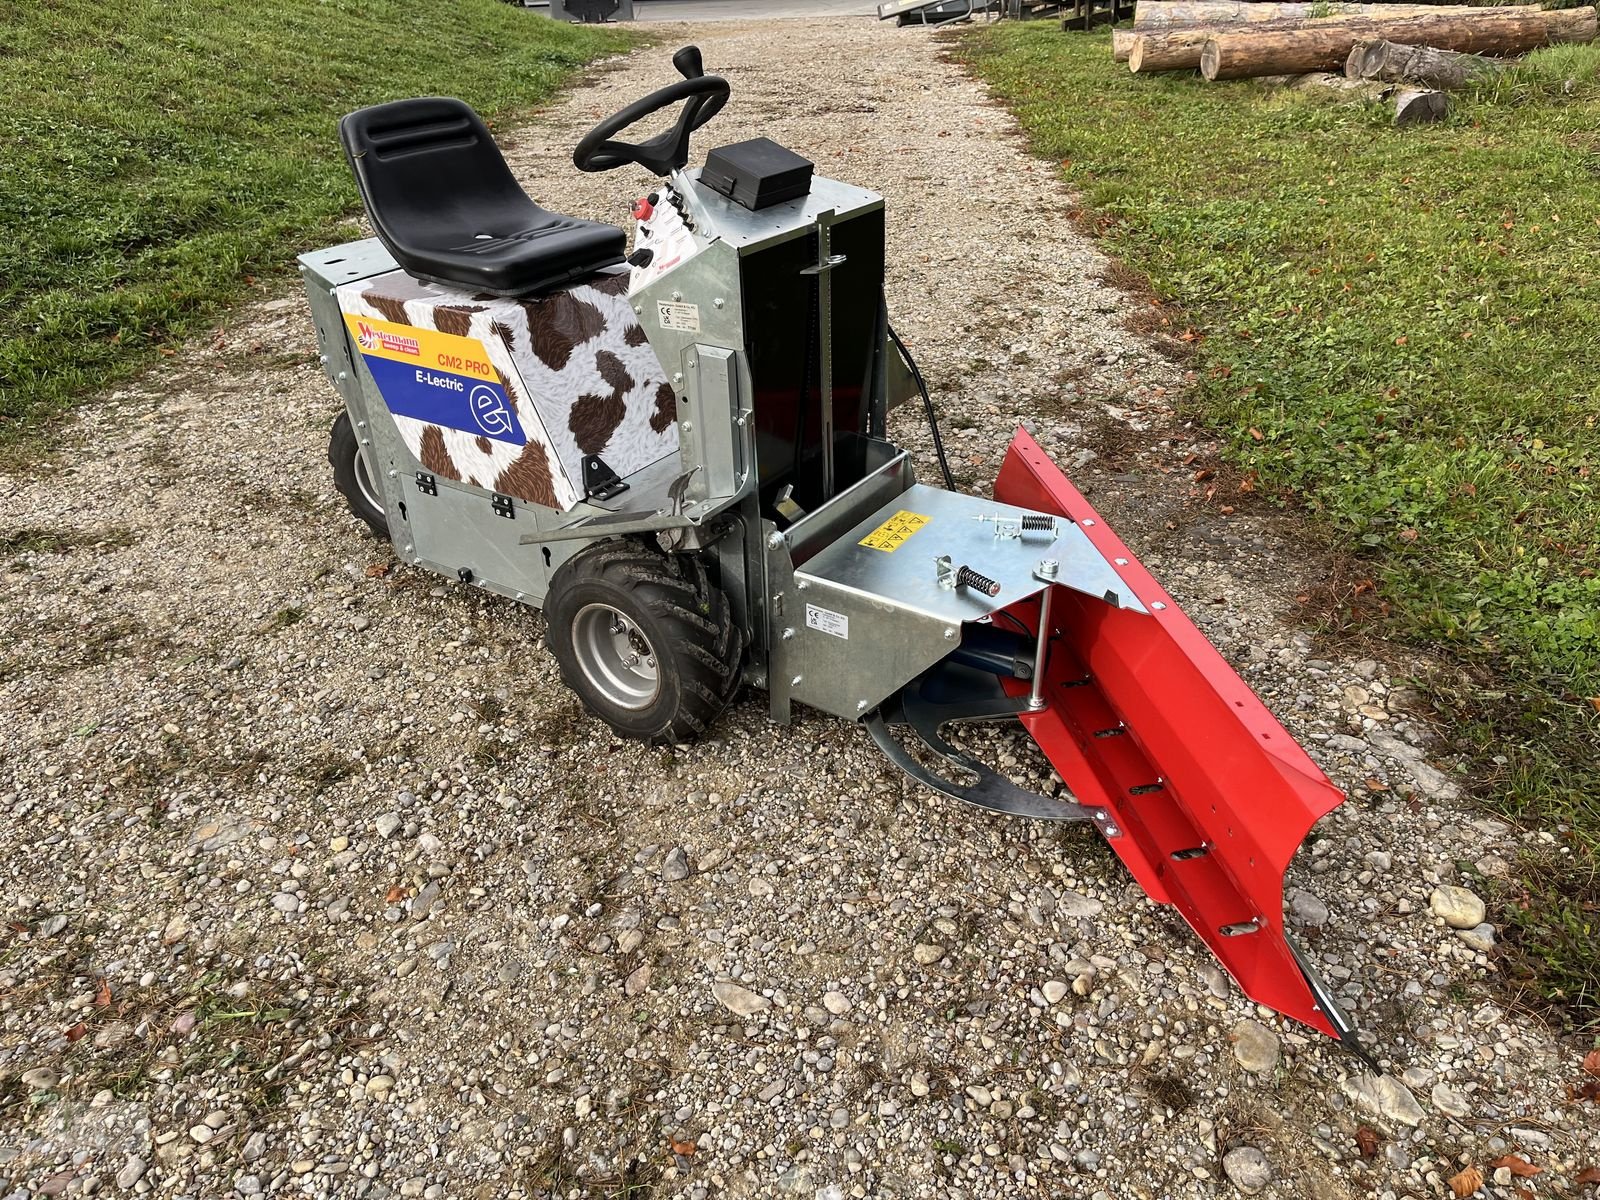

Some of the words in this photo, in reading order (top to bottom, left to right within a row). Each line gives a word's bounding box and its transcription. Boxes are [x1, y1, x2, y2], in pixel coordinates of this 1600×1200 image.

[358, 321, 419, 347] Westermann
[437, 353, 463, 370] CM2
[465, 359, 490, 376] PRO
[415, 369, 464, 392] E-Lectric
